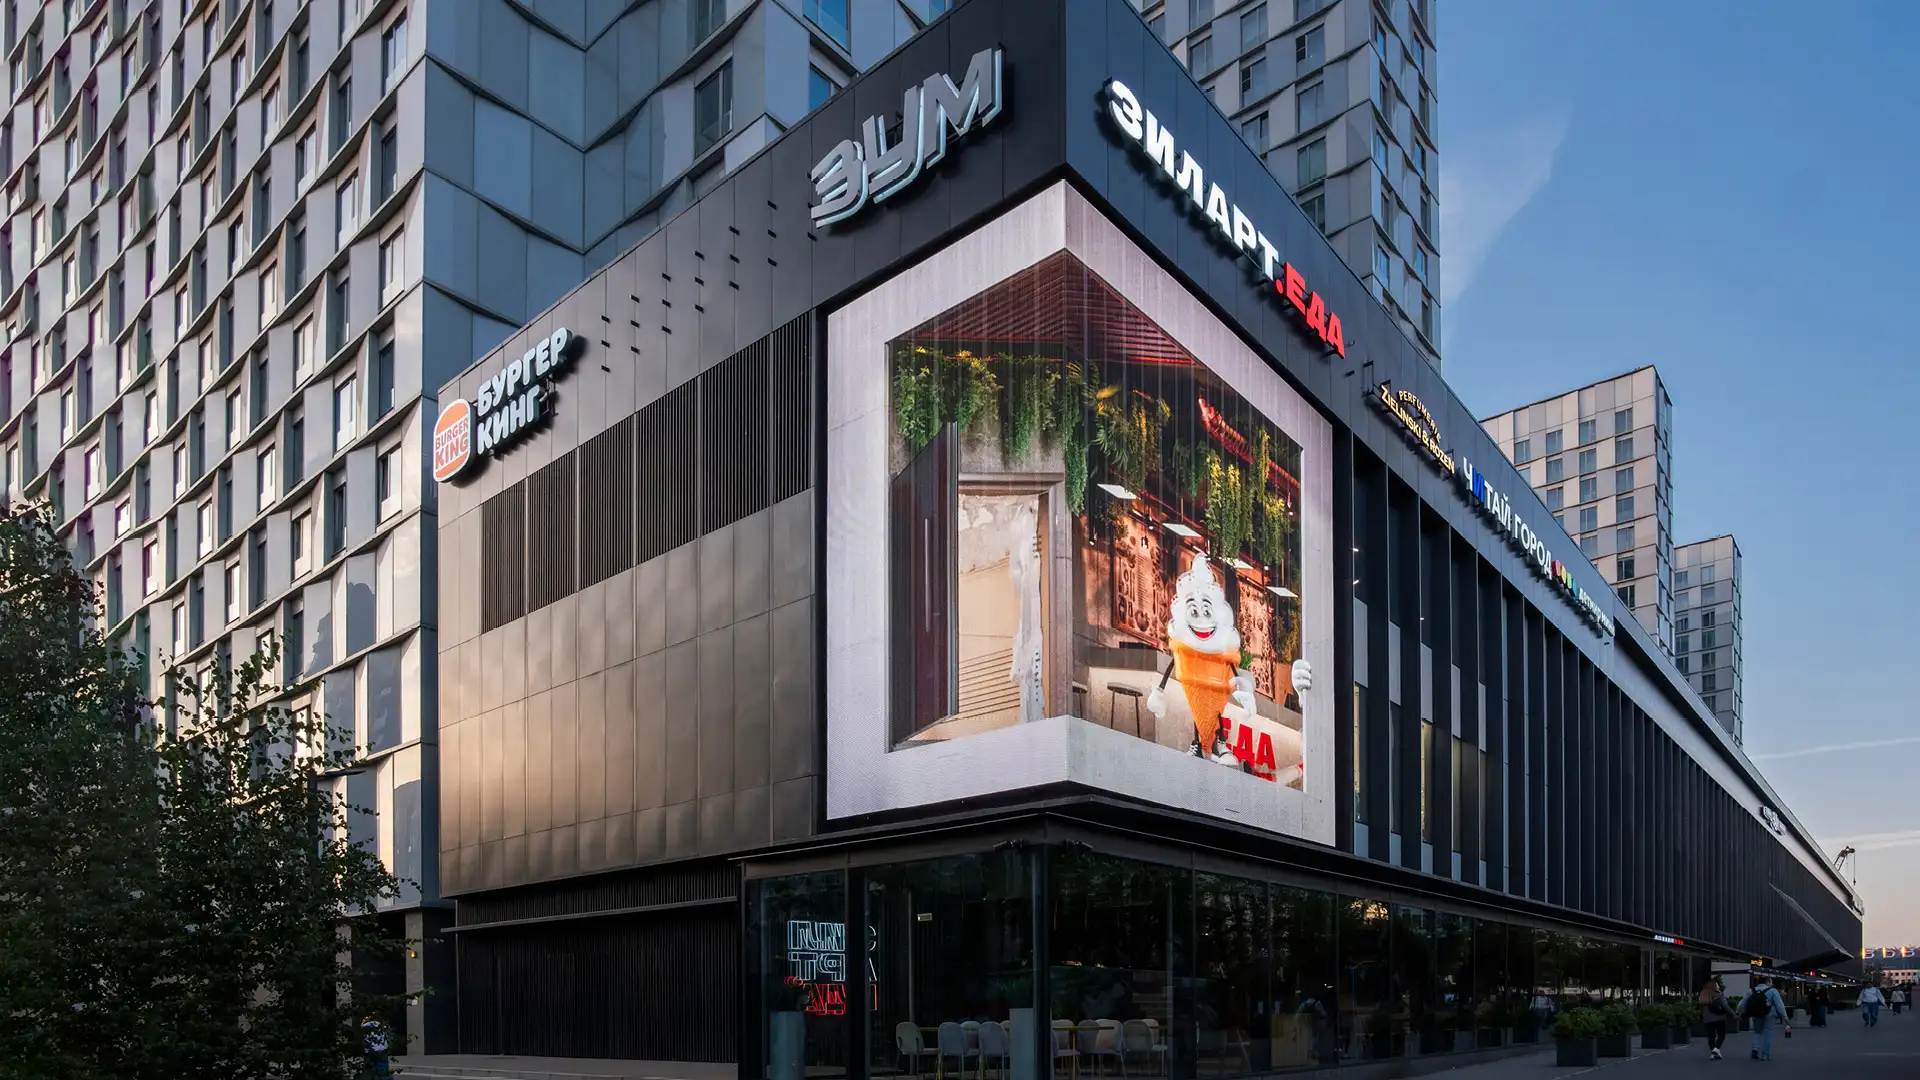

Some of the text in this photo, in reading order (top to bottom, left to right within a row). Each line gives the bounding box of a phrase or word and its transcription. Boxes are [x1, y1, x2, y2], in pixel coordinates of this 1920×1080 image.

[477, 327, 568, 417] БУРГЕР
[435, 416, 469, 450] BURGER
[435, 432, 469, 469] KING
[477, 384, 541, 455] КИНГ
[1380, 384, 1455, 475] ZIELINSKI & ROZEN
[1463, 457, 1553, 580] ЧИТАЙ ГОРОД
